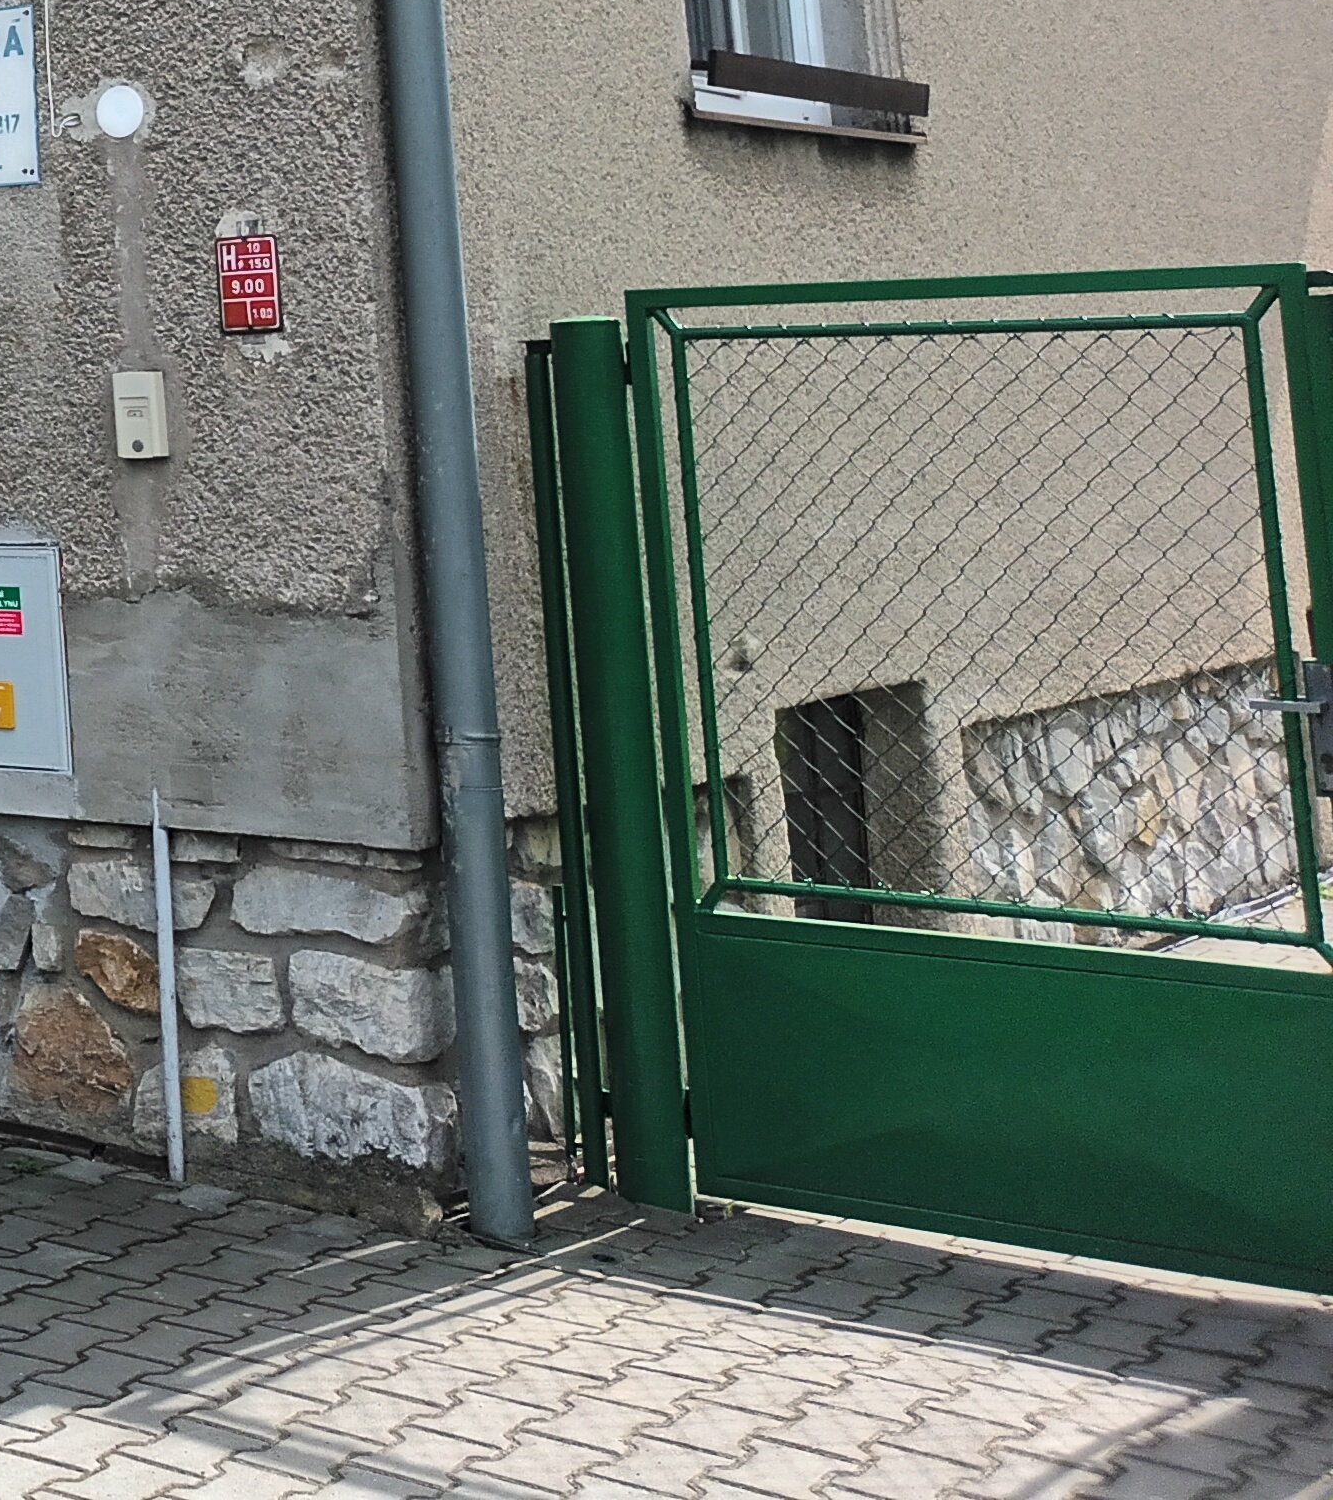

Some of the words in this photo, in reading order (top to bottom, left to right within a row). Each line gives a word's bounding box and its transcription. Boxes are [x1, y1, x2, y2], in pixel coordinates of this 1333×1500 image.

[246, 242, 261, 253] 10
[221, 244, 237, 271] H
[231, 278, 265, 295] 9.00
